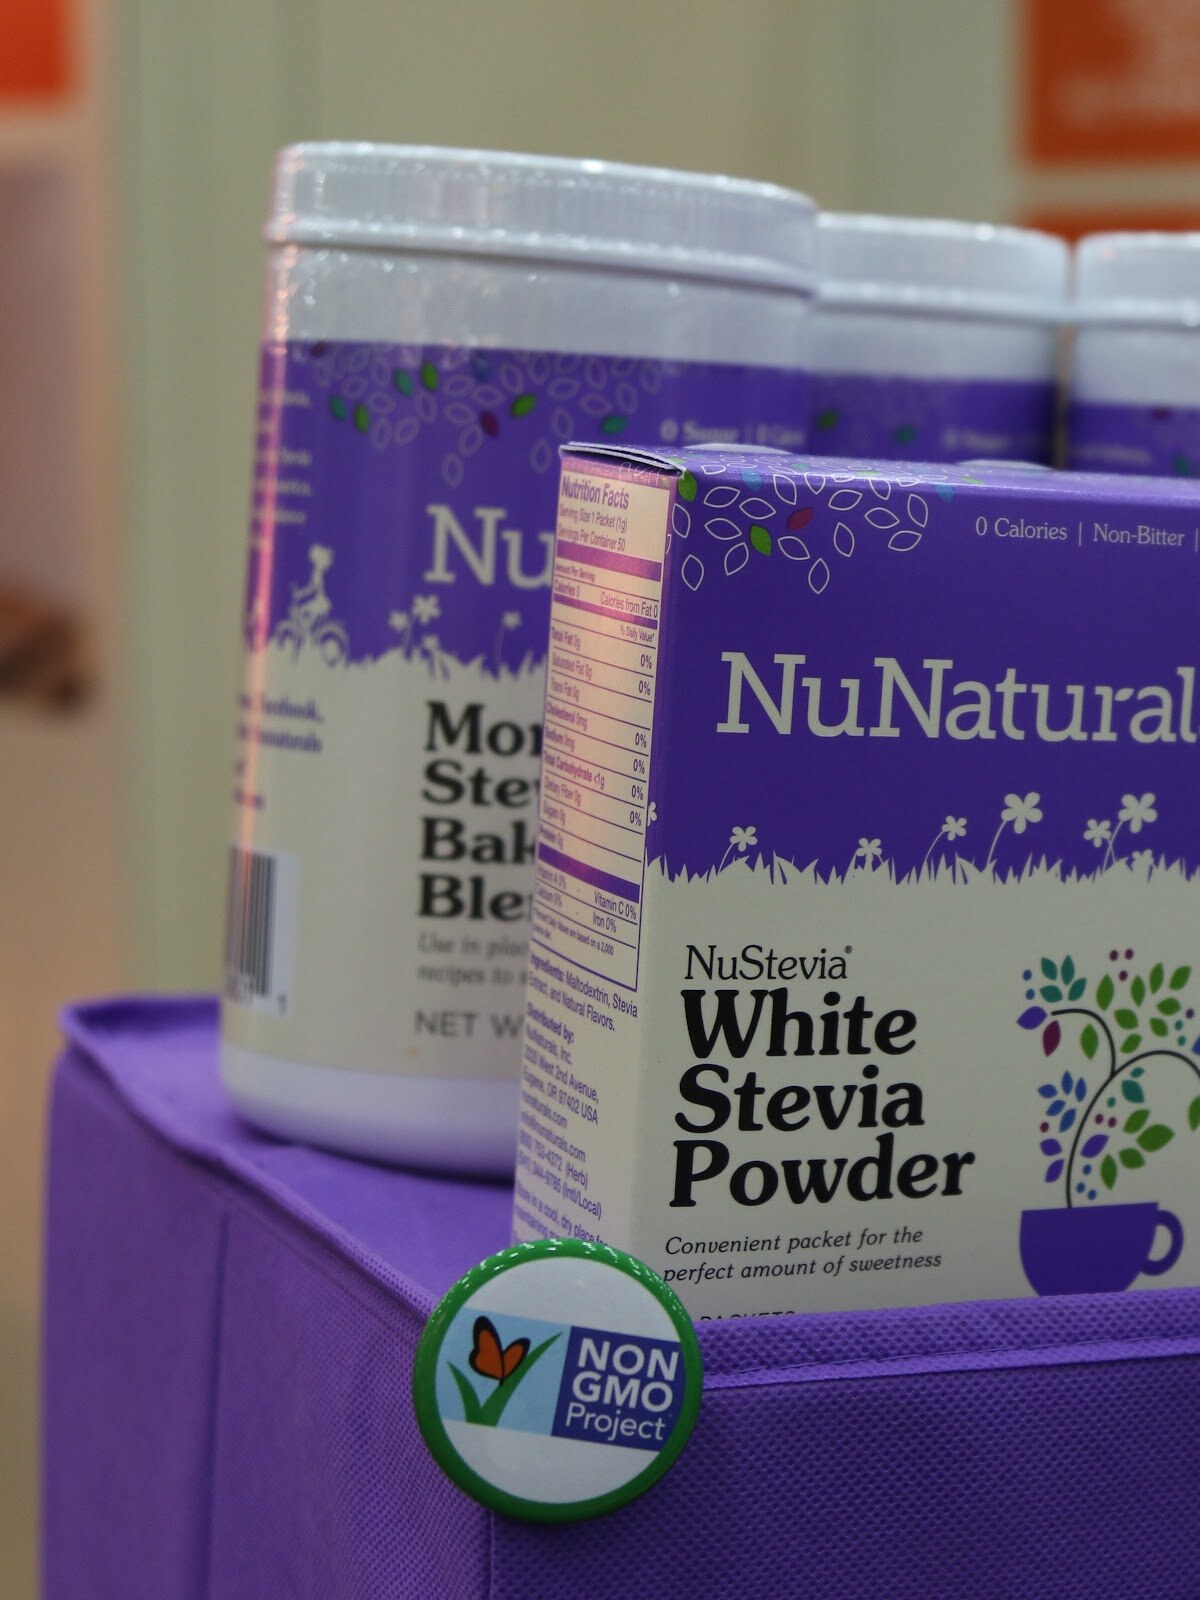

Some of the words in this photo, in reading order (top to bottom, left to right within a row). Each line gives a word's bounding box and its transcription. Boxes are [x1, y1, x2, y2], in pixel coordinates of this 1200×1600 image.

[561, 476, 600, 503] Nutrition
[602, 482, 629, 510] Facts
[559, 504, 578, 522] Serving
[579, 508, 590, 521] Size
[596, 512, 616, 528] Packet
[616, 517, 628, 534] (1g)
[976, 516, 987, 536] 0
[994, 517, 1068, 540] Calories
[1093, 523, 1185, 546] Non-Bitter
[558, 524, 579, 543] Servings
[580, 529, 589, 542] Per
[591, 531, 617, 550] Container
[618, 538, 626, 552] 50
[553, 578, 575, 595] Calories
[601, 592, 625, 610] Calories
[625, 598, 640, 614] from
[641, 602, 652, 617] Fat
[654, 605, 659, 619] 0
[626, 626, 638, 642] Daily
[565, 631, 573, 645] Fat
[640, 654, 653, 669] 0%
[552, 652, 576, 672] Saturated
[576, 660, 585, 676] Fat
[638, 680, 651, 696] 0%
[564, 681, 573, 697] Fat
[546, 701, 576, 724] Cholesterol
[634, 732, 647, 748] 0%
[556, 756, 593, 782] Carbohydrate
[631, 785, 644, 801] 0%
[633, 758, 645, 774] 0%
[421, 758, 540, 808] Ste
[629, 811, 642, 827] 0%
[417, 873, 531, 921] Ble
[594, 890, 617, 912] Vitamin
[618, 901, 624, 915] C
[625, 904, 637, 920] 0%
[593, 912, 605, 929] Iron
[606, 917, 617, 933] 0%
[577, 931, 590, 946] based
[601, 940, 615, 956] 2,000
[530, 953, 565, 982] Ingredients:
[566, 971, 611, 1009] Maltodextrin,
[613, 993, 638, 1018] Stevia
[415, 1010, 479, 1037] NET
[562, 991, 585, 1017] Natural
[587, 1004, 615, 1032] Flavors.
[680, 987, 917, 1058] White
[563, 1025, 574, 1045] by:
[561, 1046, 573, 1066] Inc.
[569, 1074, 599, 1103] Avenue,
[675, 1063, 925, 1133] Stevia
[558, 1089, 580, 1115] 97402
[581, 1104, 598, 1125] USA
[565, 1162, 589, 1191] (Herb)
[669, 1132, 976, 1207] Powder
[561, 1214, 573, 1236] dry
[574, 1223, 595, 1242] place
[665, 1234, 781, 1255] Convenient
[787, 1230, 852, 1254] packet
[856, 1228, 887, 1250] for
[893, 1226, 923, 1244] the
[663, 1262, 734, 1284] perfect
[741, 1260, 816, 1278] amount
[823, 1255, 845, 1277] of
[849, 1253, 942, 1272] sweetness
[578, 1338, 680, 1381] NON
[572, 1371, 674, 1412] GMO
[565, 1402, 667, 1441] Project
